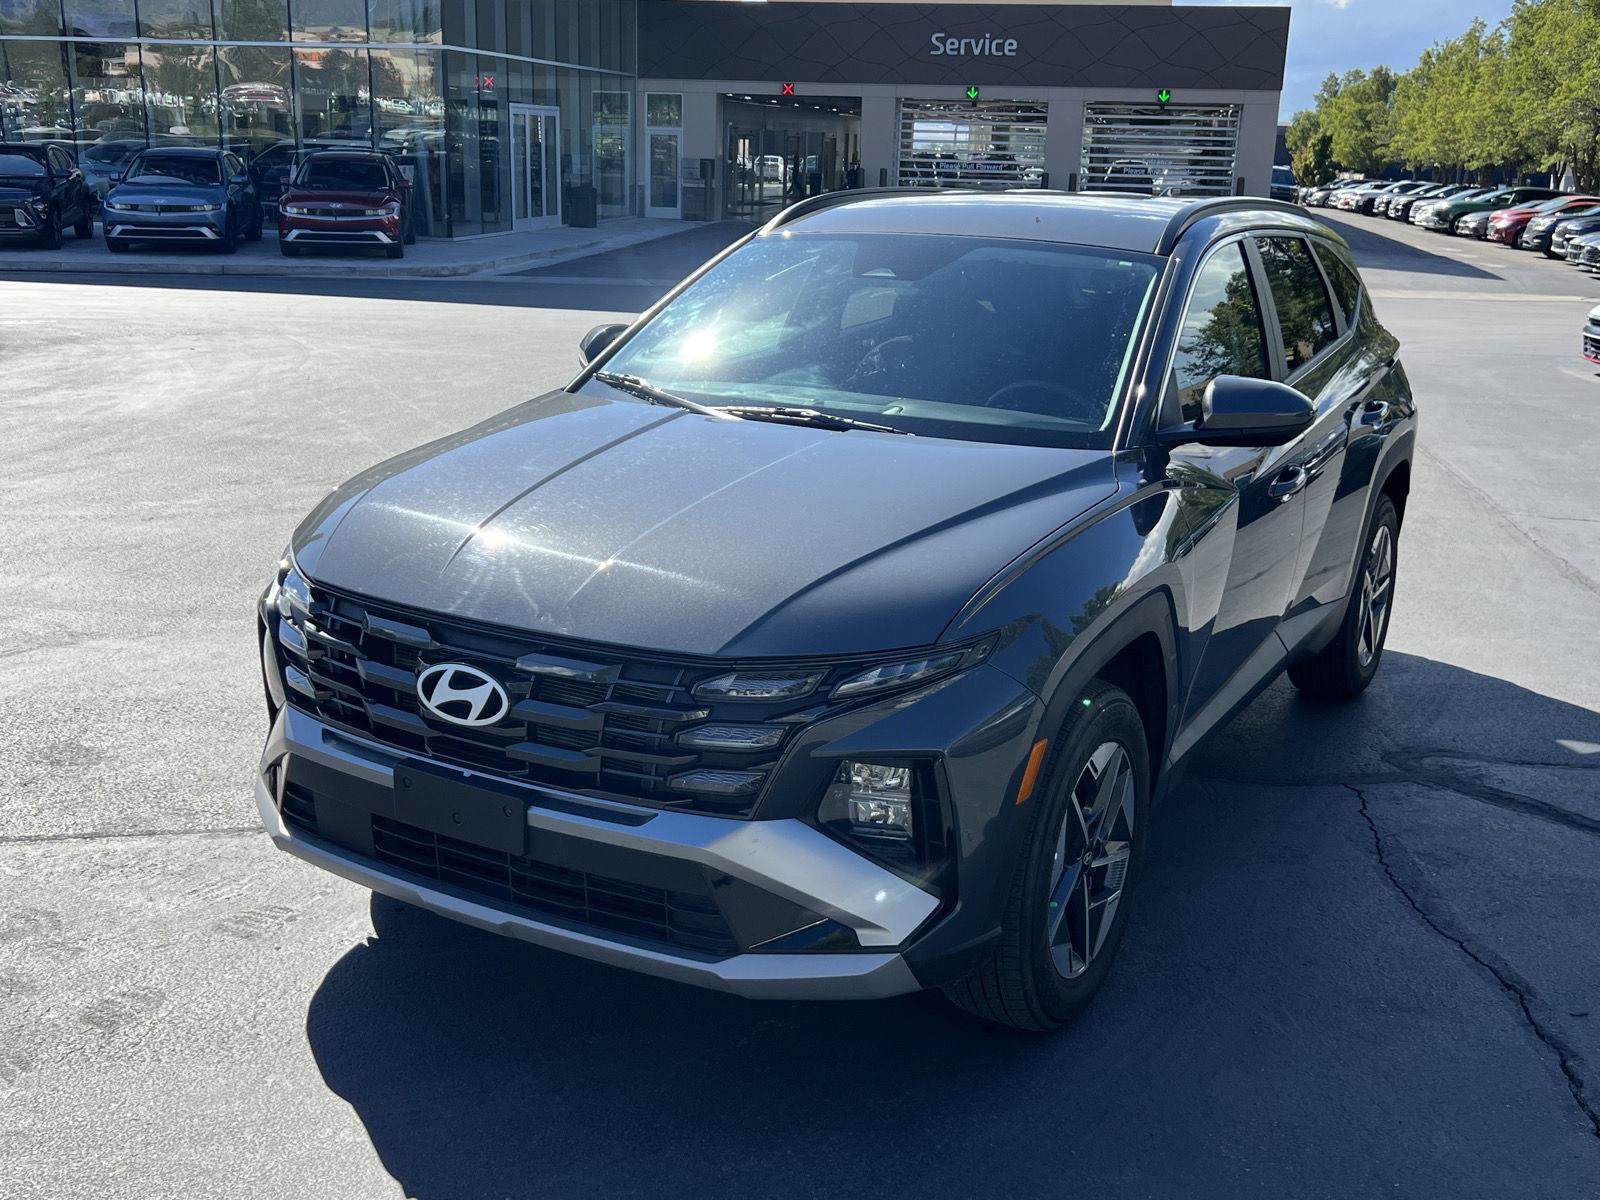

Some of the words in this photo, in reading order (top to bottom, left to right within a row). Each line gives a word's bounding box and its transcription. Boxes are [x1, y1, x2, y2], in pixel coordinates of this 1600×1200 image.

[930, 32, 1018, 56] Service
[939, 161, 961, 170] Please
[962, 162, 975, 171] Pull
[975, 163, 1003, 171] Forward
[1123, 167, 1145, 175] Please
